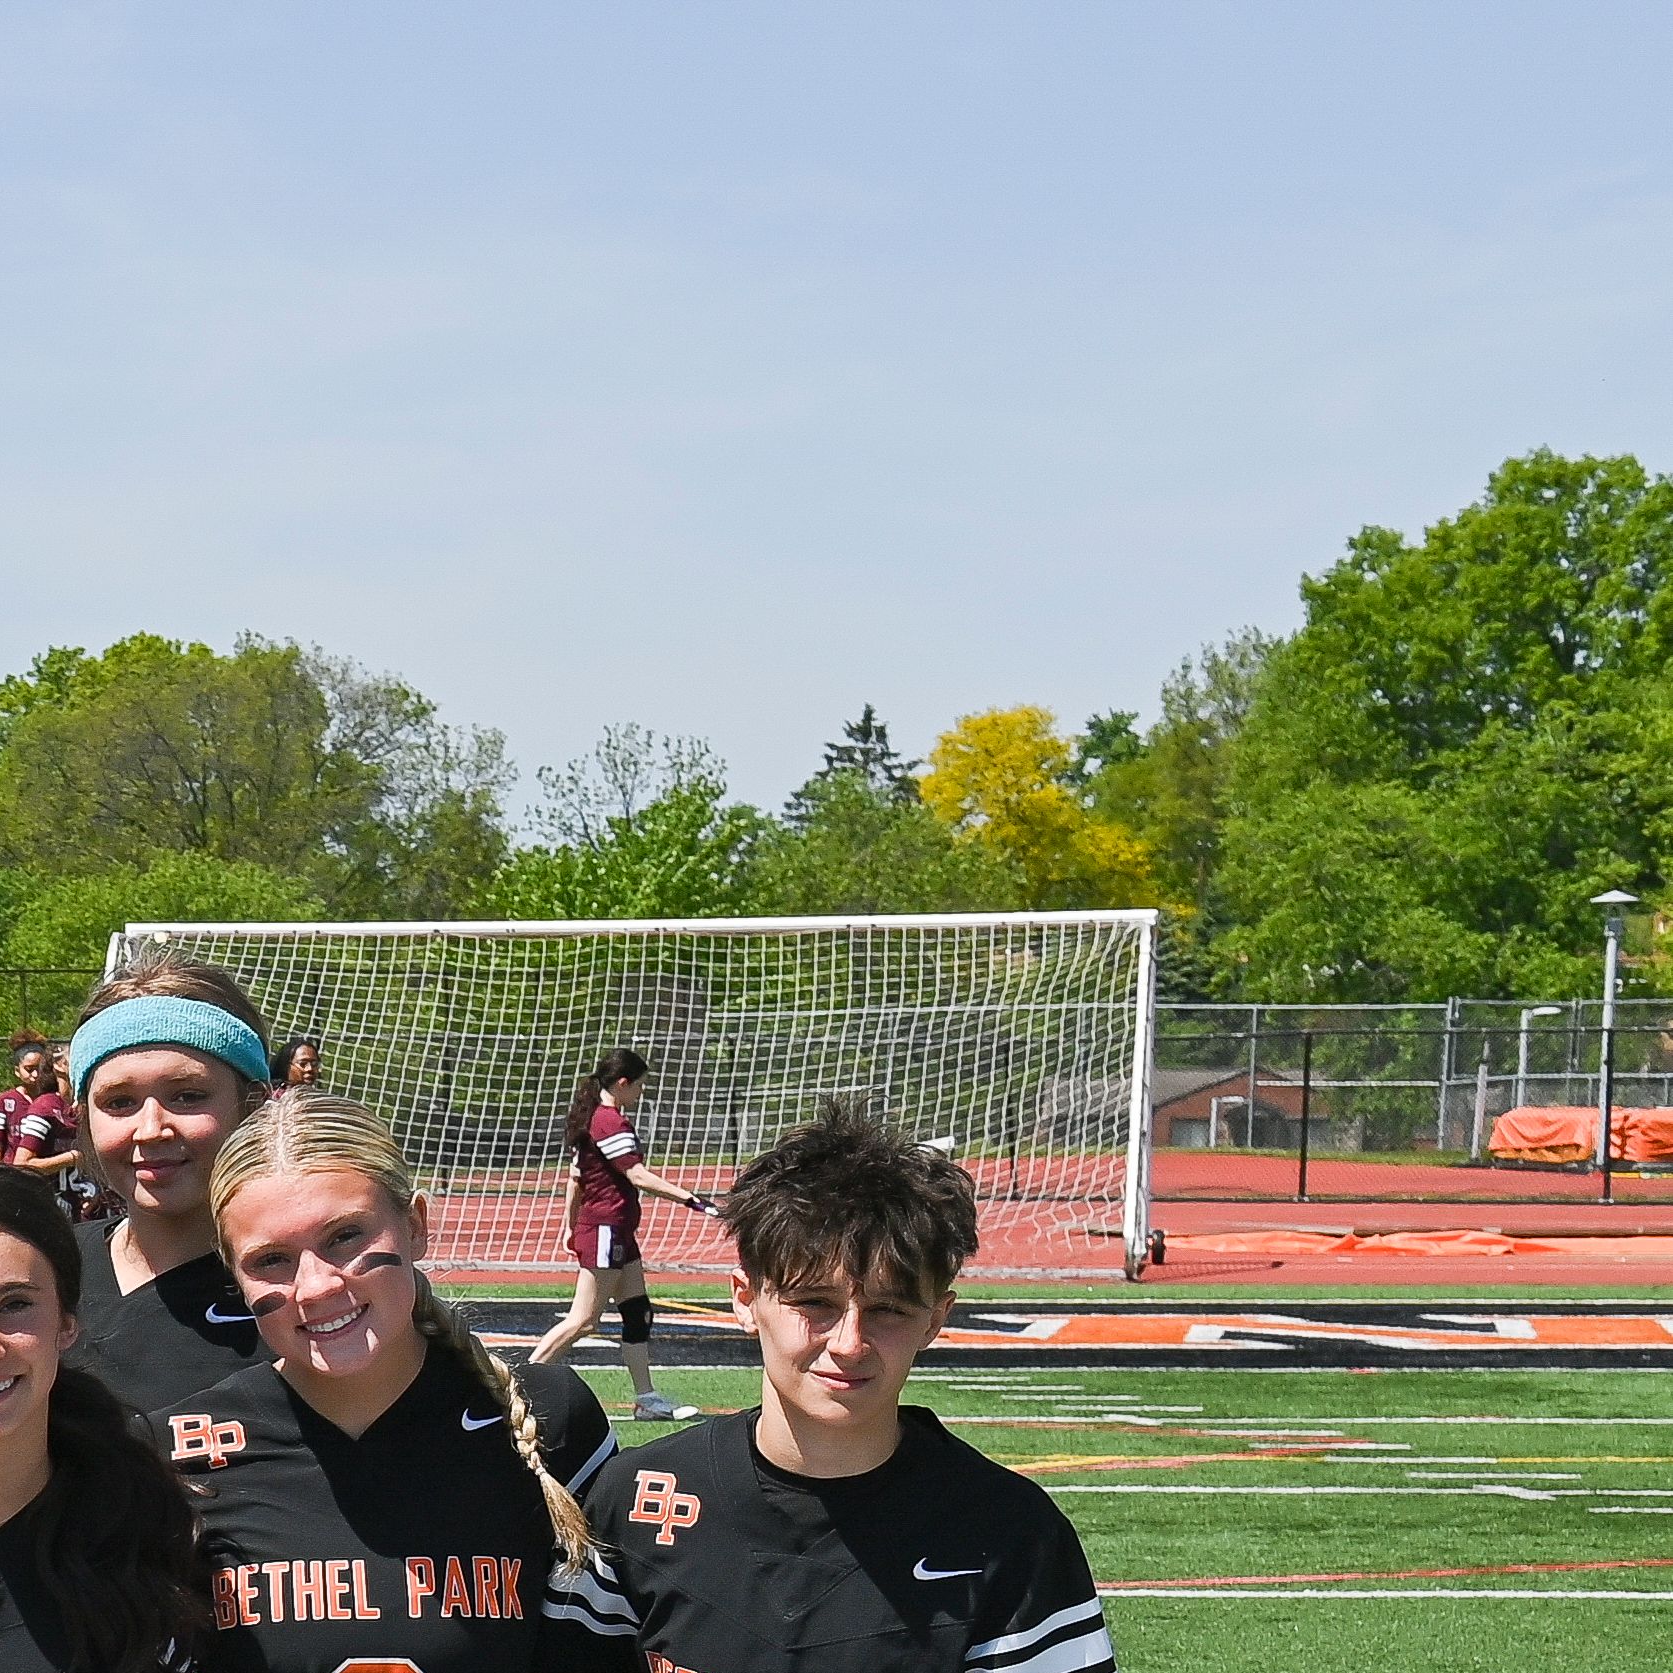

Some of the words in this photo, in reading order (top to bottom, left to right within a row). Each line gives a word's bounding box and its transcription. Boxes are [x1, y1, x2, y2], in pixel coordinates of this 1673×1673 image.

[167, 1413, 246, 1468] BP
[627, 1469, 701, 1545] BP
[212, 1559, 380, 1630] BETHEL
[405, 1556, 523, 1621] PARK
